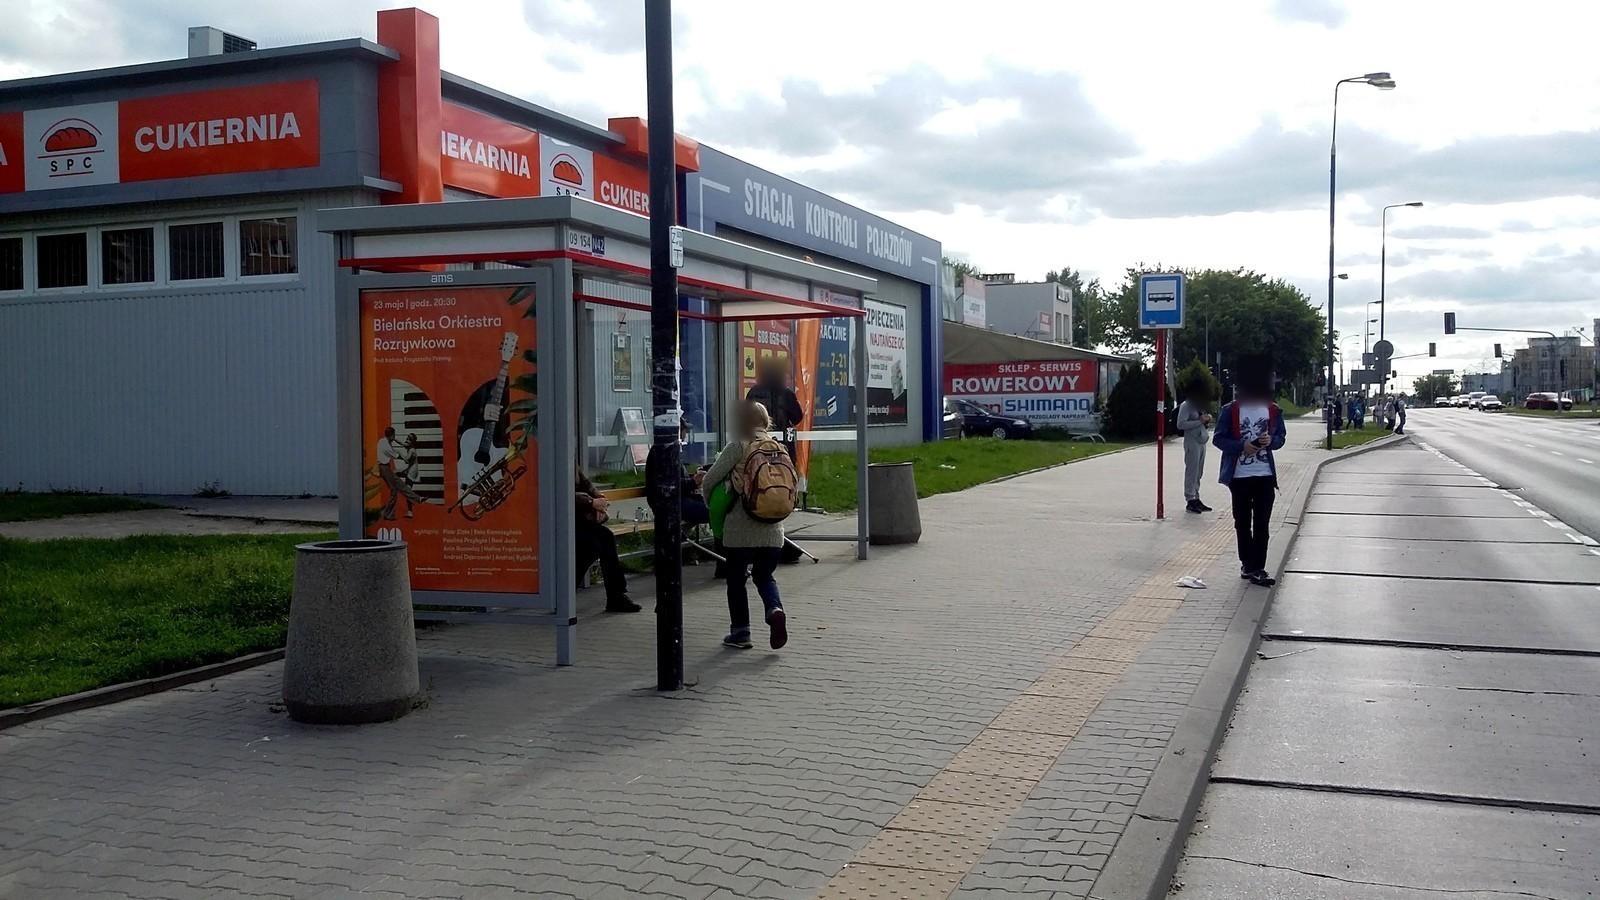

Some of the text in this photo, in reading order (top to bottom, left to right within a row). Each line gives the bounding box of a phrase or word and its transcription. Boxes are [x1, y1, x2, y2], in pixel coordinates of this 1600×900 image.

[135, 112, 300, 153] CUKIERNIA
[441, 130, 531, 179] IEKARNIA
[600, 180, 650, 213] CUKIER
[744, 178, 912, 267] STACJA KONTROLI POJAZDÓW
[569, 233, 578, 245] 09
[580, 235, 591, 248] 154
[431, 274, 453, 283] ams
[373, 298, 456, 310] 23 maja godz. 20:30
[373, 315, 501, 332] Bielańska Orkiestra
[373, 336, 456, 353] Rozrywkowa
[998, 363, 1081, 373] SKLEP SERWIS
[952, 375, 1079, 393] ROWEROWY
[1004, 399, 1090, 411] SHIMANO
